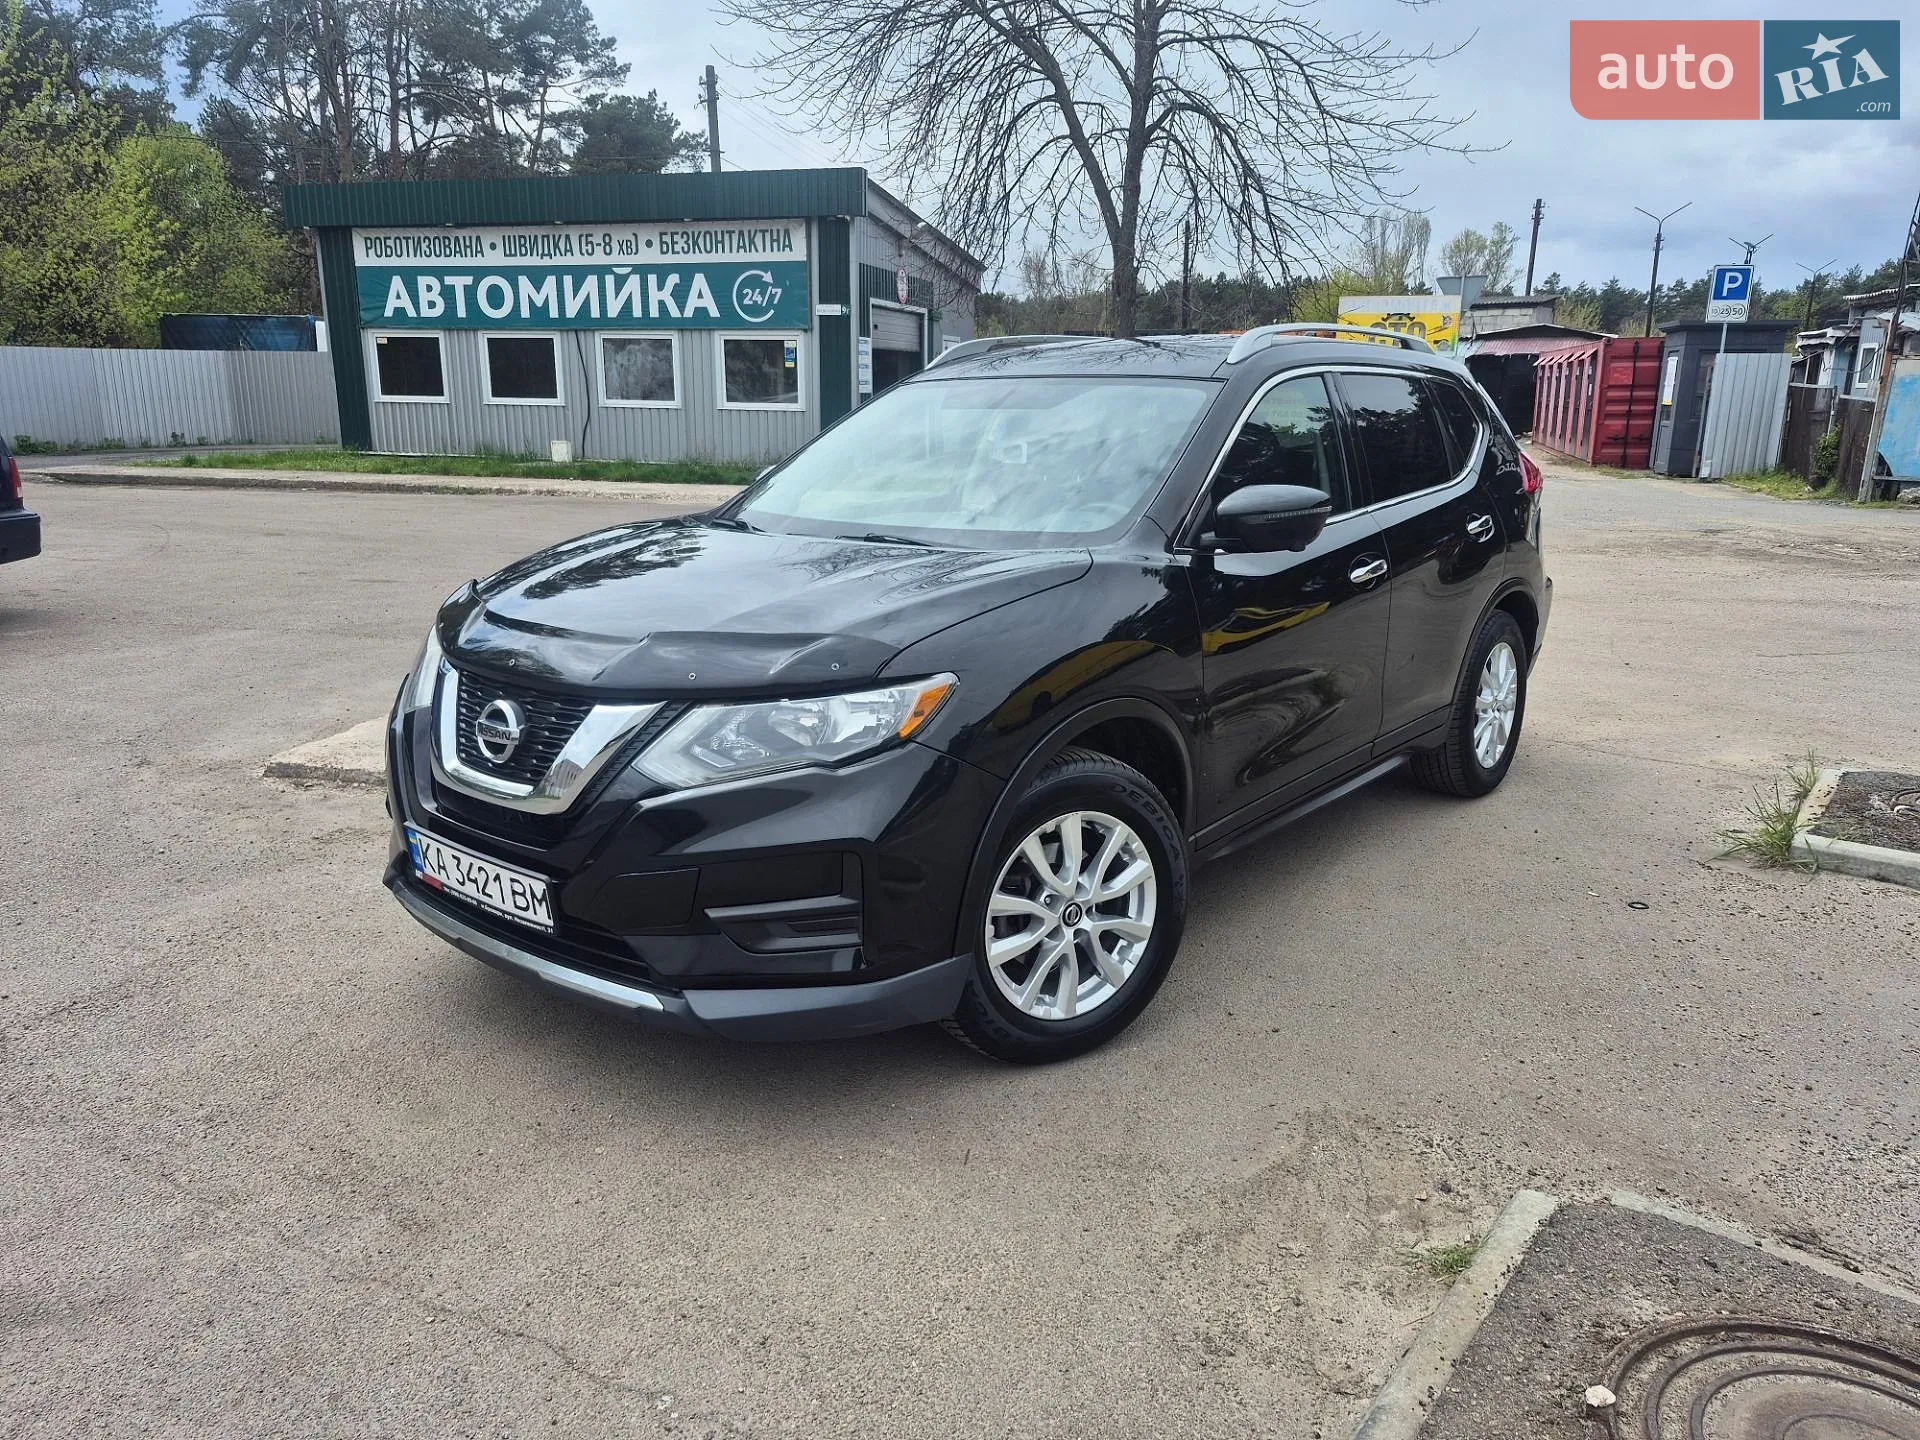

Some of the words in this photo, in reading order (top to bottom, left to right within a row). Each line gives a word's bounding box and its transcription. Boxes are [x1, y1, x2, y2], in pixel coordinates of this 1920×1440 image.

[364, 234, 485, 259] РОБОТИЗОВАНА
[502, 233, 574, 260] ШВИДКА
[659, 228, 794, 256] БЕЗКОНТАКТНА
[383, 267, 721, 319] АВТОМИЙКА
[742, 287, 783, 307] 24/7
[1721, 271, 1743, 297] P
[1732, 307, 1743, 316] 50
[418, 838, 450, 881] KA
[451, 855, 506, 905] 3421
[510, 877, 553, 921] BM
